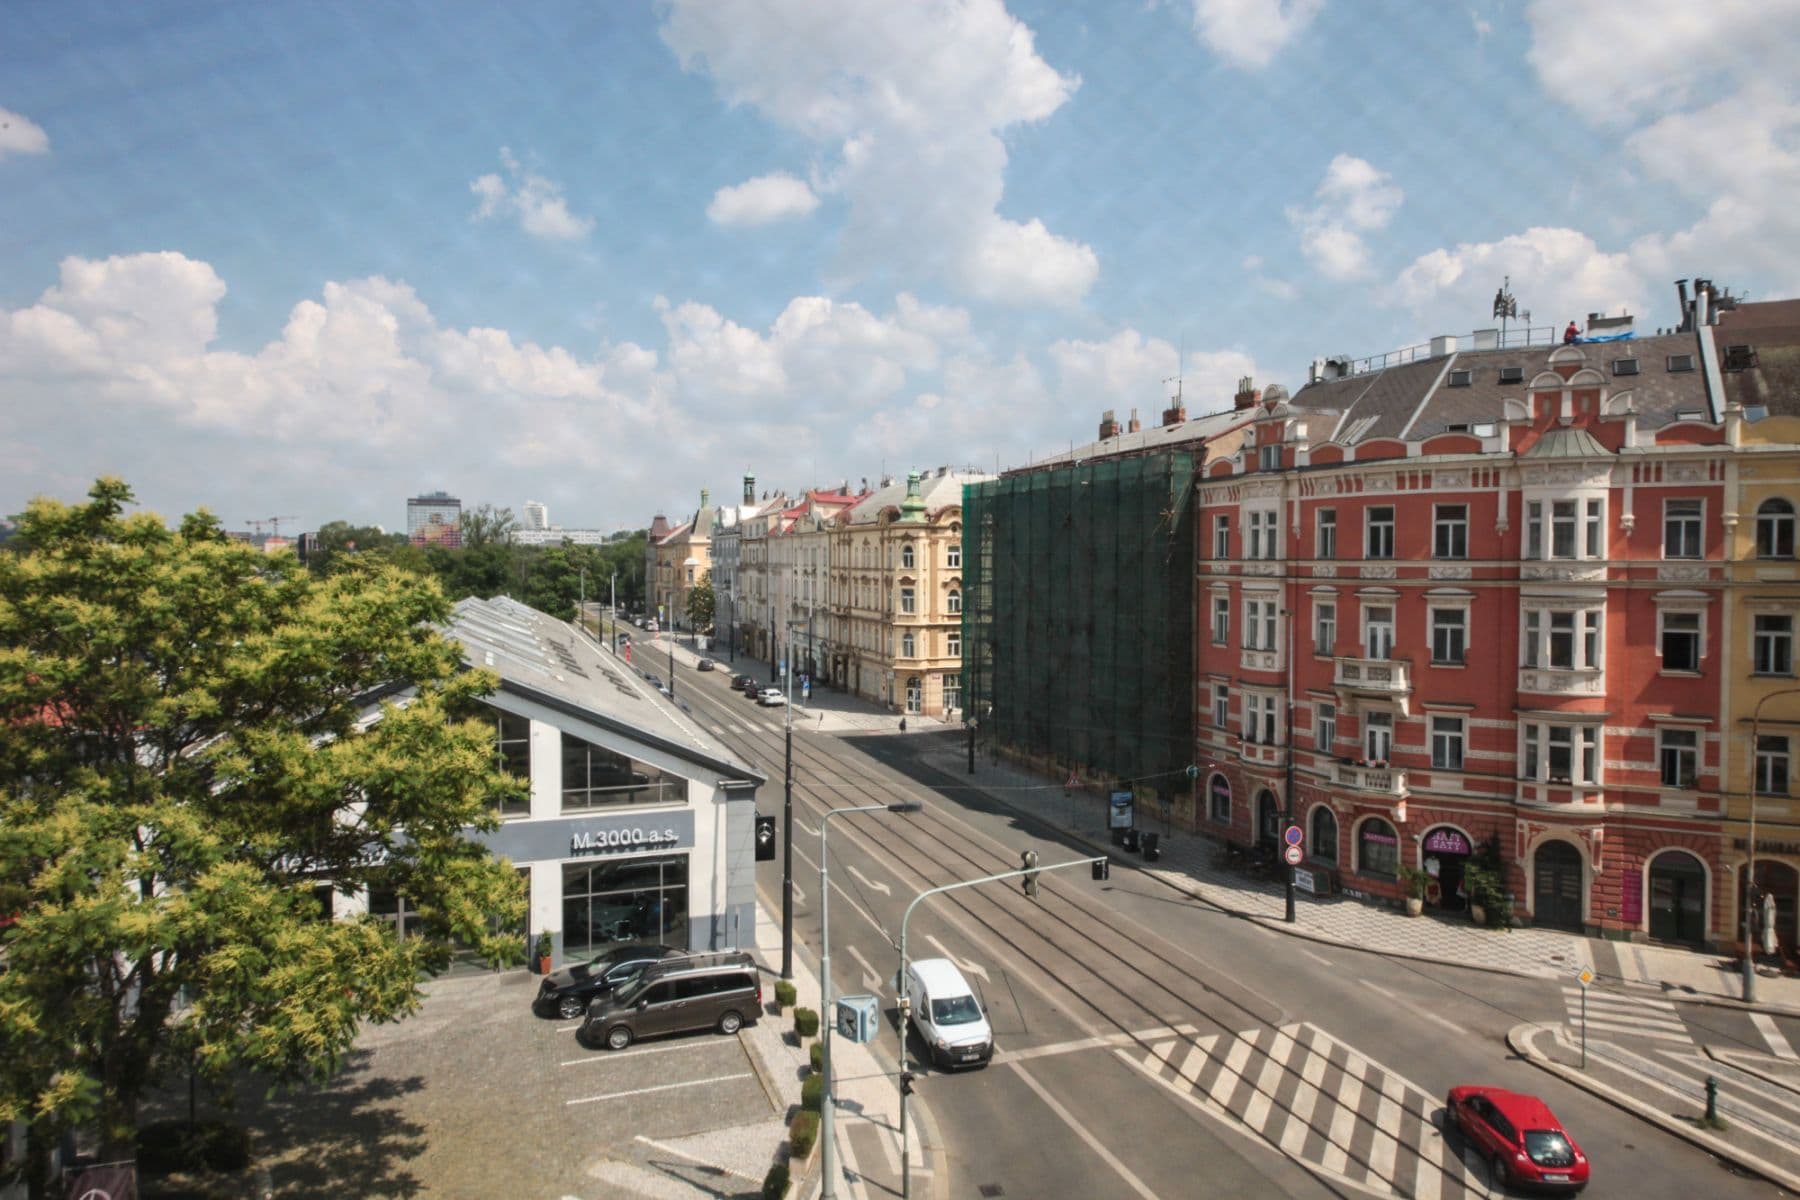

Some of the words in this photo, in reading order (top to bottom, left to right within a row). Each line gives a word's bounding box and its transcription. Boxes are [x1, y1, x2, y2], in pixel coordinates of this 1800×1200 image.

[573, 831, 592, 849] M
[596, 828, 643, 848] 3000
[649, 828, 680, 843] a.s.
